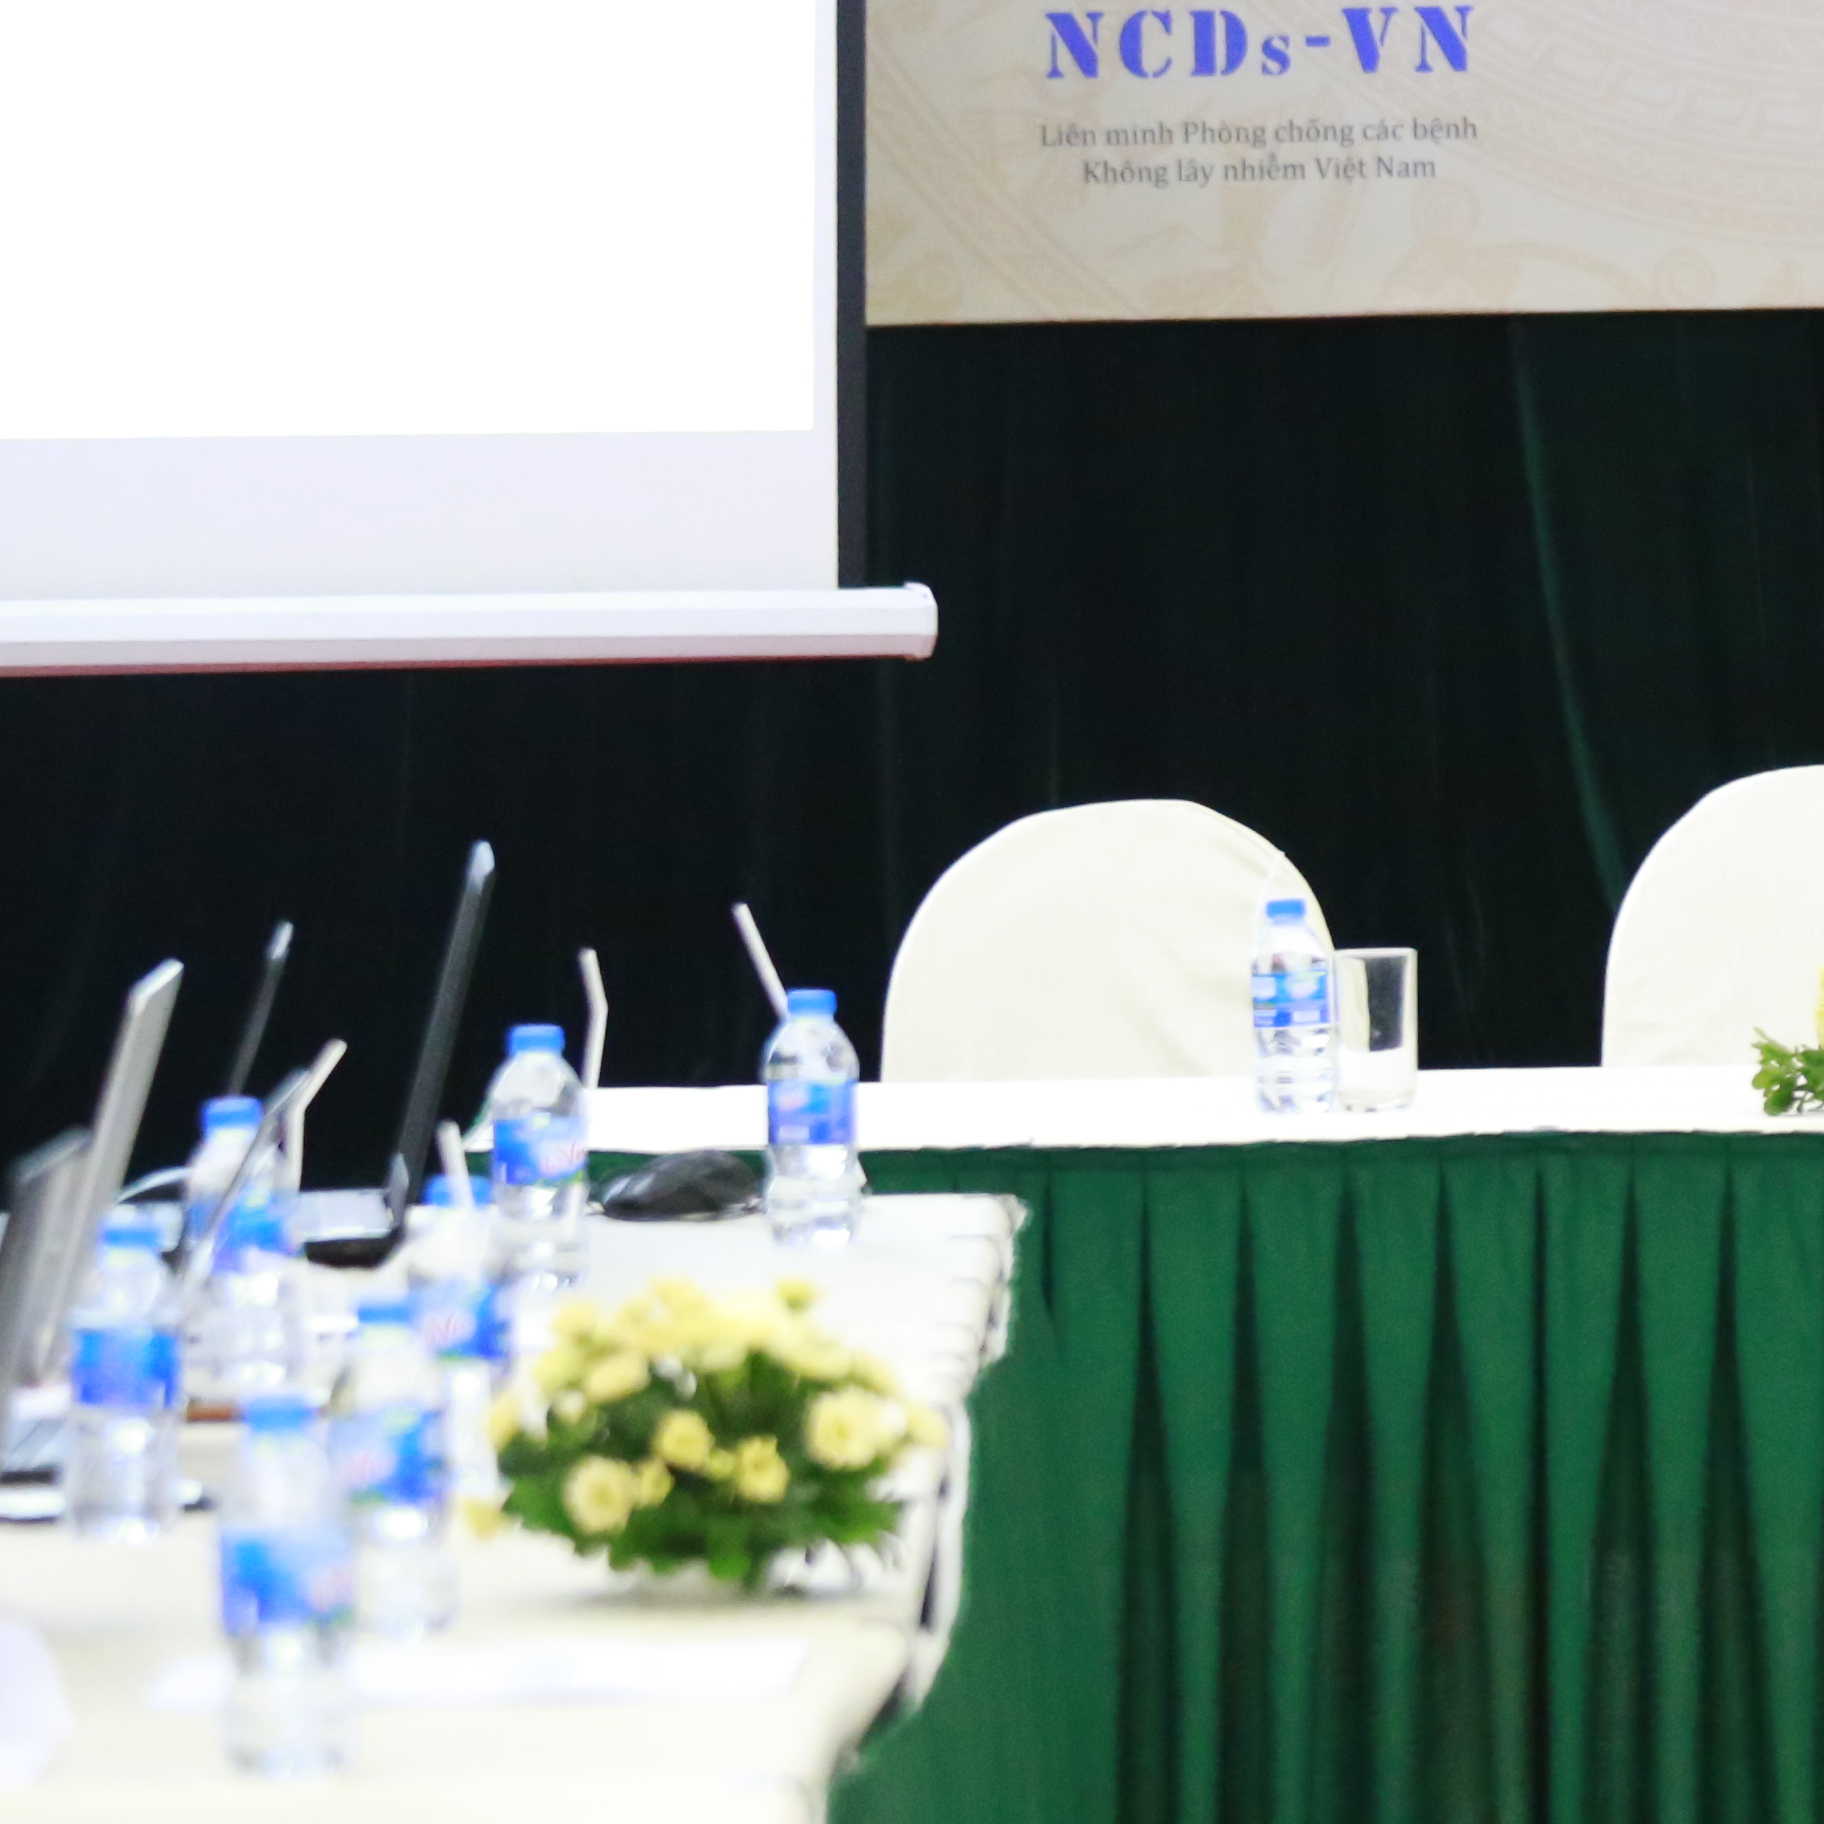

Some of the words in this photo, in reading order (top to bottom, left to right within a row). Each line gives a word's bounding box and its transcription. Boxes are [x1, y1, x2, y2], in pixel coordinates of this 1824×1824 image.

[1047, 5, 1471, 78] NCDs-VN
[1042, 122, 1097, 147] Liên
[1105, 121, 1174, 147] minh
[1183, 120, 1268, 148] Phòng
[1273, 117, 1355, 148] chống
[1361, 120, 1404, 142] các
[1412, 116, 1479, 144] bệnh
[1083, 159, 1169, 188] Không
[1177, 159, 1214, 188] lây
[1223, 151, 1307, 182] nhiễm
[1315, 156, 1366, 182] Việt
[1376, 154, 1437, 179] Nam
